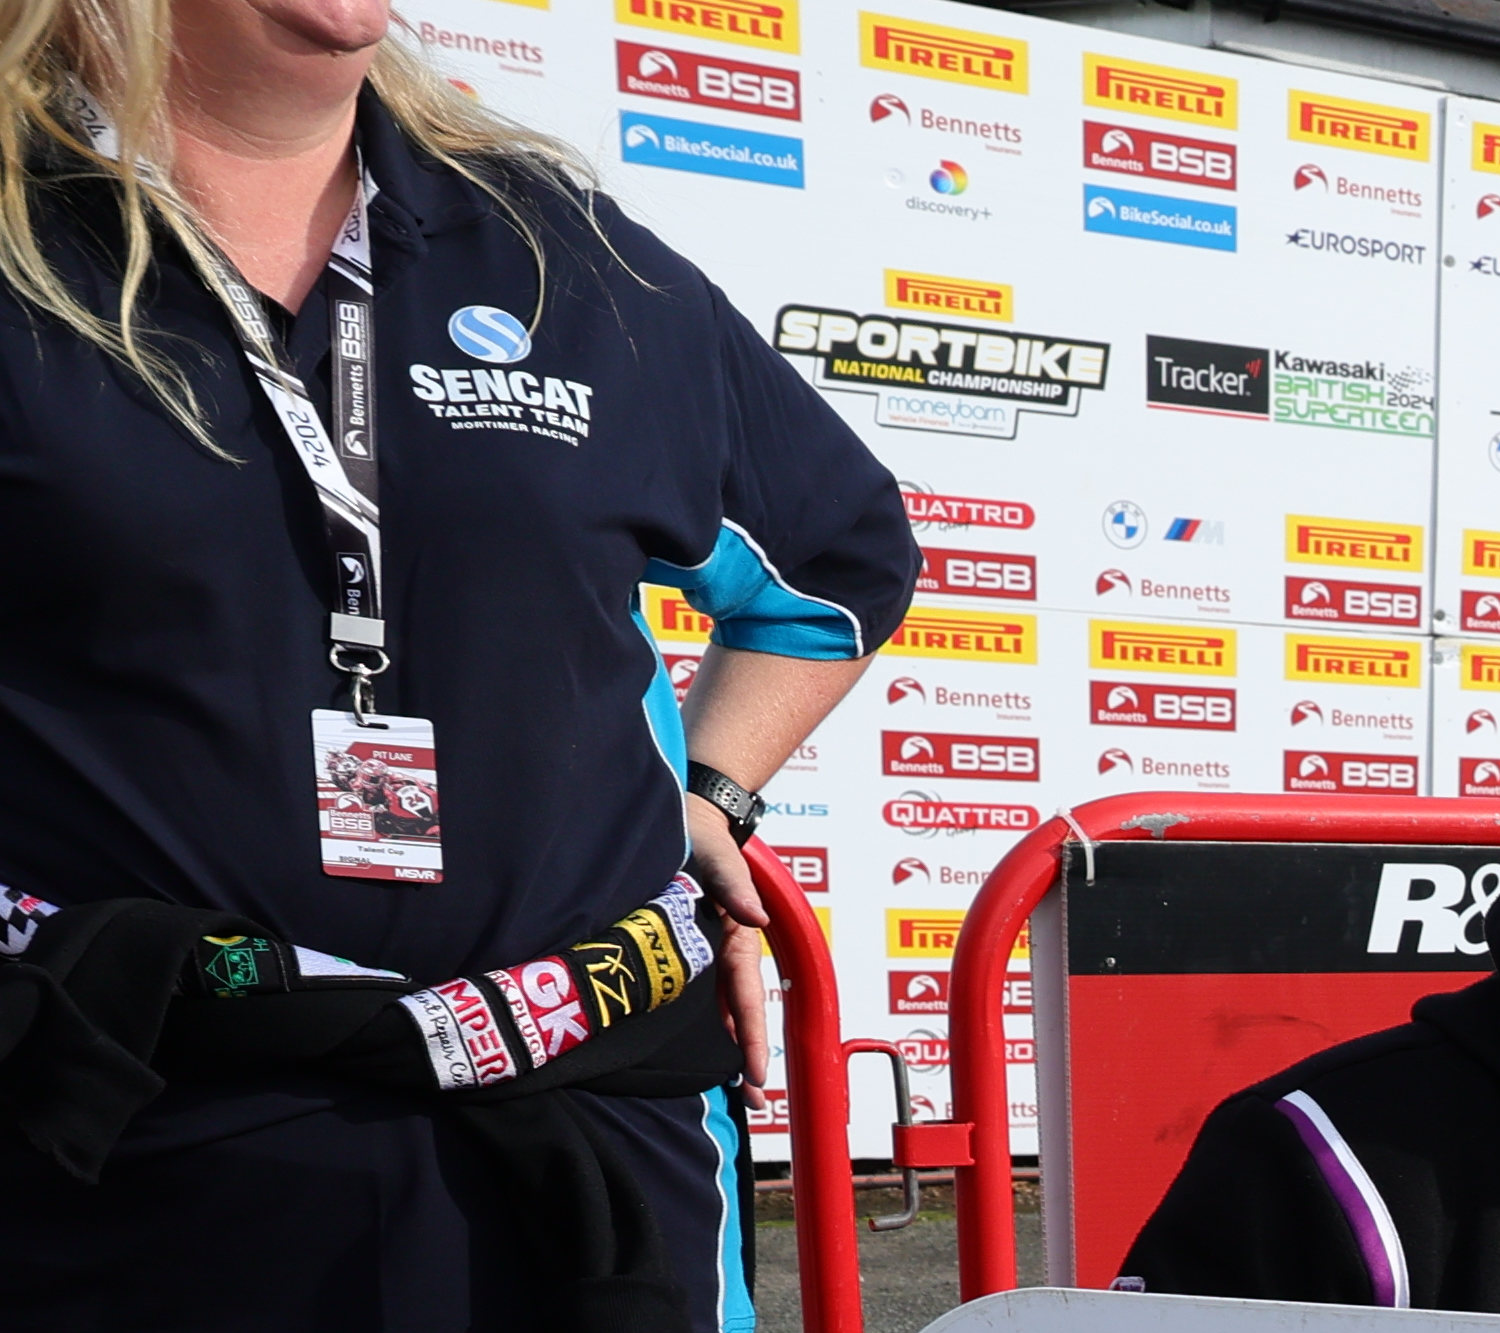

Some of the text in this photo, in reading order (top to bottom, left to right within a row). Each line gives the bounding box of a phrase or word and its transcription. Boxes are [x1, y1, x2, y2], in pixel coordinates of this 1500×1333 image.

[420, 21, 544, 64] Bennetts
[873, 26, 1014, 81] PIRELLI
[627, 65, 797, 109] Bennetts BSB
[1096, 64, 1225, 118] PIRELLI
[920, 108, 1022, 143] Bennetts
[664, 135, 798, 172] BikeSocial.co.uk
[1151, 142, 1232, 180] BSB
[906, 195, 992, 221] discovery+
[1337, 177, 1422, 207] Bennetts
[1119, 205, 1232, 237] BikeSocial.co.uk
[1286, 229, 1425, 264] EUROSPORT
[897, 277, 1002, 315] PIRELLI
[779, 312, 1104, 384] SPORTBIKE
[340, 303, 366, 427] BSB Bennetts
[833, 359, 1062, 399] NATIONAL CHAMPIONSHIP
[1155, 355, 1248, 397] Tracker
[1275, 350, 1385, 382] Kawasaki
[409, 363, 594, 421] SENCAT
[1275, 374, 1384, 404] BRITISH
[1386, 391, 1434, 411] 2024
[429, 403, 590, 439] TALENT TEAM
[888, 396, 1006, 424] moneybarn
[1275, 401, 1434, 433] SUPERTEEN
[286, 410, 328, 469] 2024
[451, 420, 579, 447] MORTIMER RACING
[1297, 525, 1411, 564] PIRELLI
[946, 559, 1032, 591] BSB
[1141, 579, 1231, 602] Bennetts
[935, 687, 1032, 711] Bennetts
[1332, 709, 1414, 732] Bennetts
[389, 752, 413, 763] LANE
[952, 744, 1036, 774] BSB
[331, 817, 373, 831] BSB
[891, 801, 1029, 830] QUATTRO
[395, 868, 436, 880] MSVR
